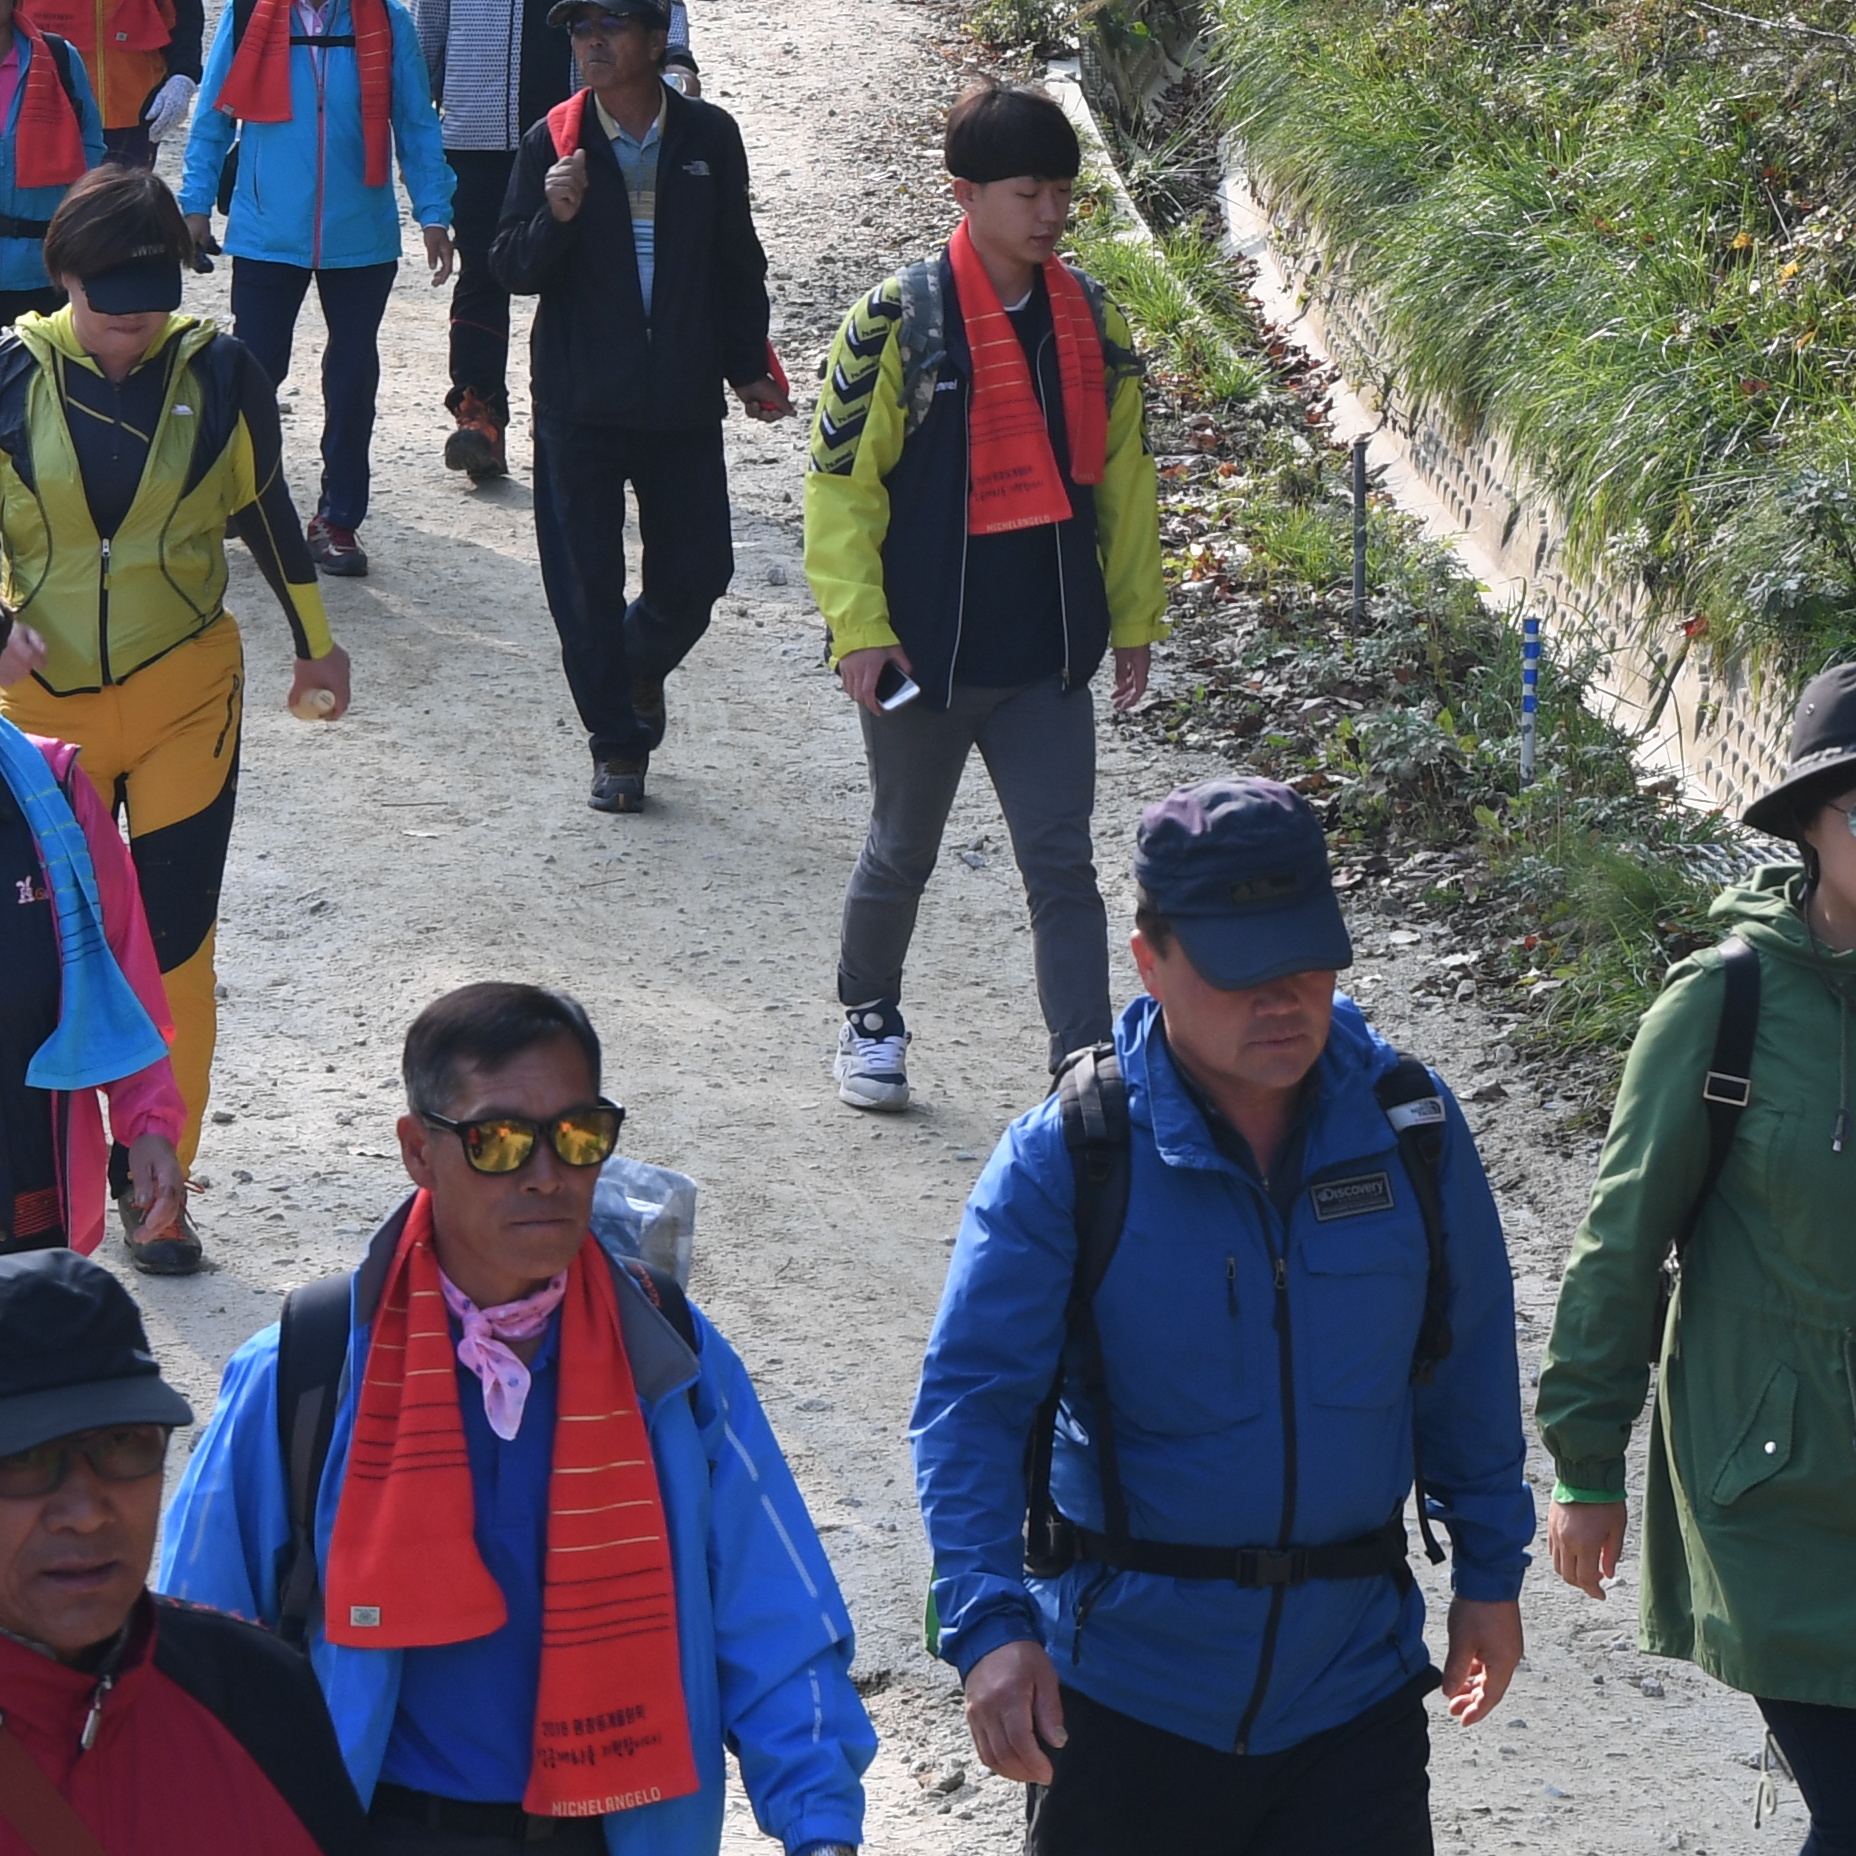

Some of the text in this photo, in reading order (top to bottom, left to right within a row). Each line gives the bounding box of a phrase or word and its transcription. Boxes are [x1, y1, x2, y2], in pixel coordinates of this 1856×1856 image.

[861, 324, 888, 338] hummel
[837, 404, 866, 424] hummel
[824, 449, 854, 470] hummel
[986, 514, 1051, 533] MICHELANGELO
[552, 1787, 662, 1817] MICHELANGELO
